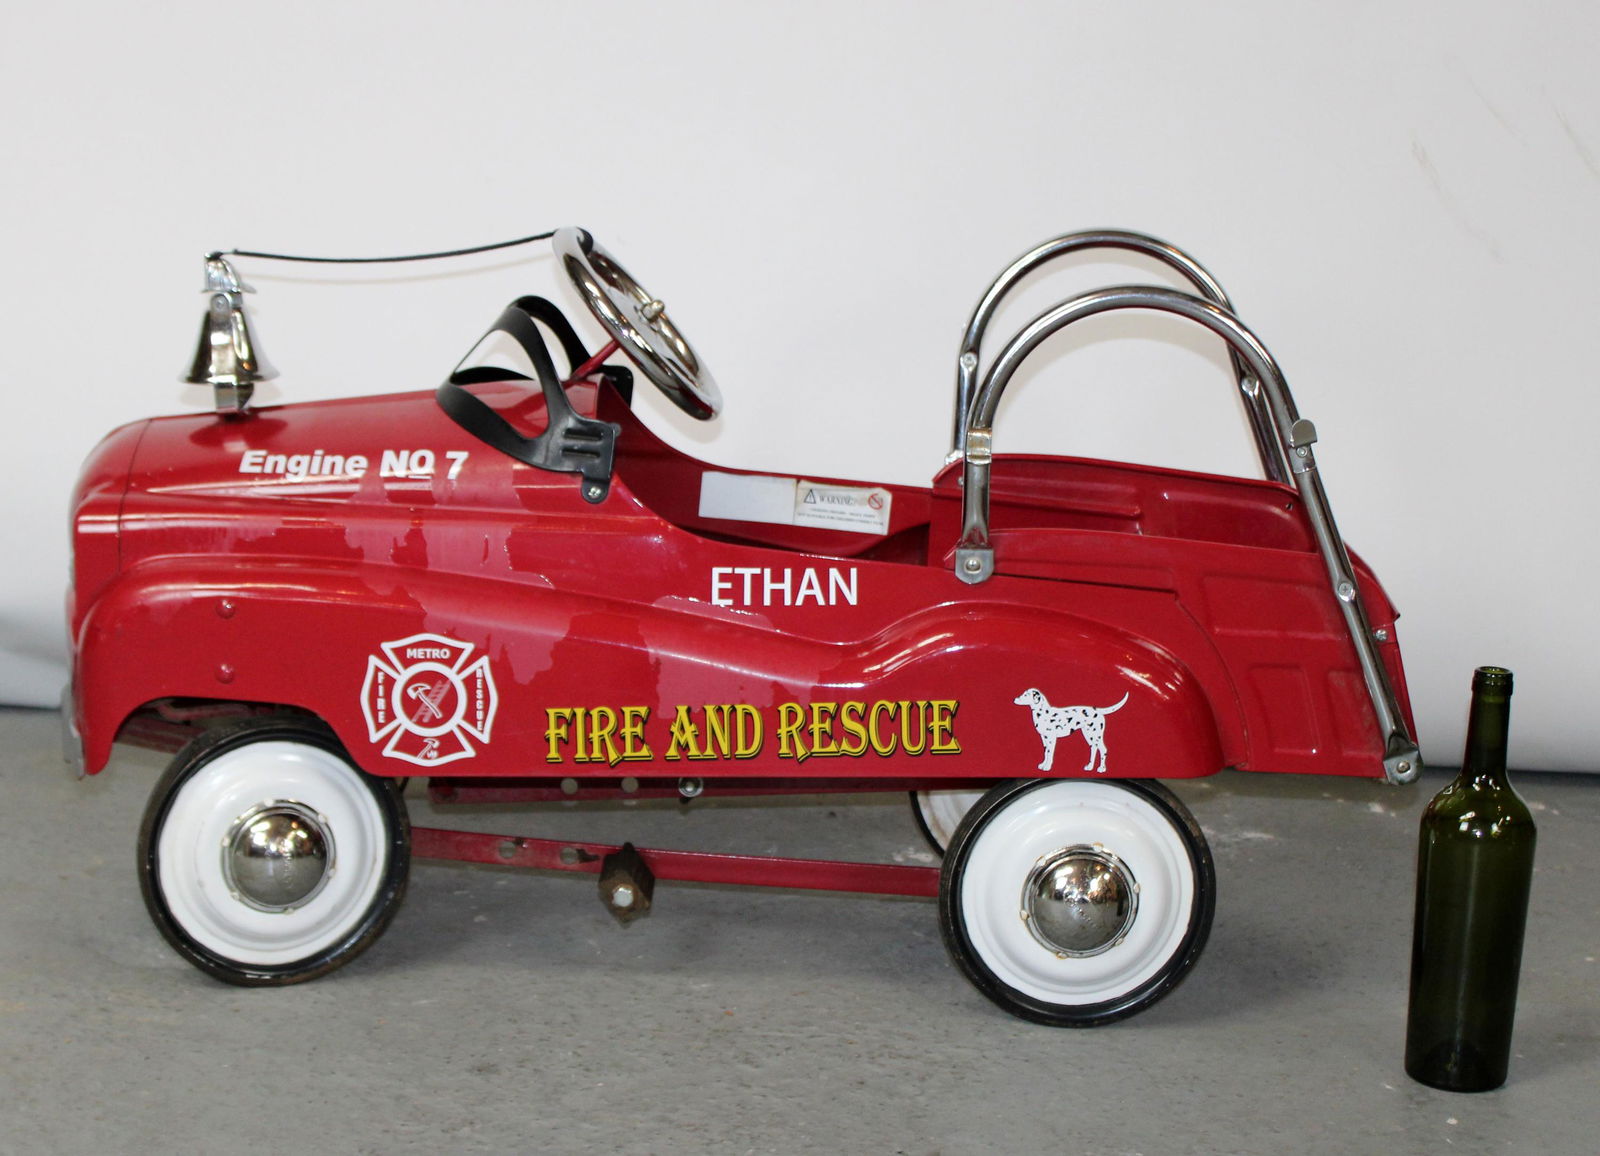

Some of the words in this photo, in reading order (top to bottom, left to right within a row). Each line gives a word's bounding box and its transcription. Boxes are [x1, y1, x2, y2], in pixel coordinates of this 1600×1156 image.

[239, 449, 368, 483] Engine
[446, 450, 469, 480] 7
[711, 566, 858, 606] ETHAN
[406, 648, 450, 659] METRO
[377, 671, 386, 724] FIRE
[475, 668, 484, 731] RESCUE
[544, 705, 654, 767] FIRE
[664, 704, 764, 760] AND
[776, 700, 962, 765] RESCUE
